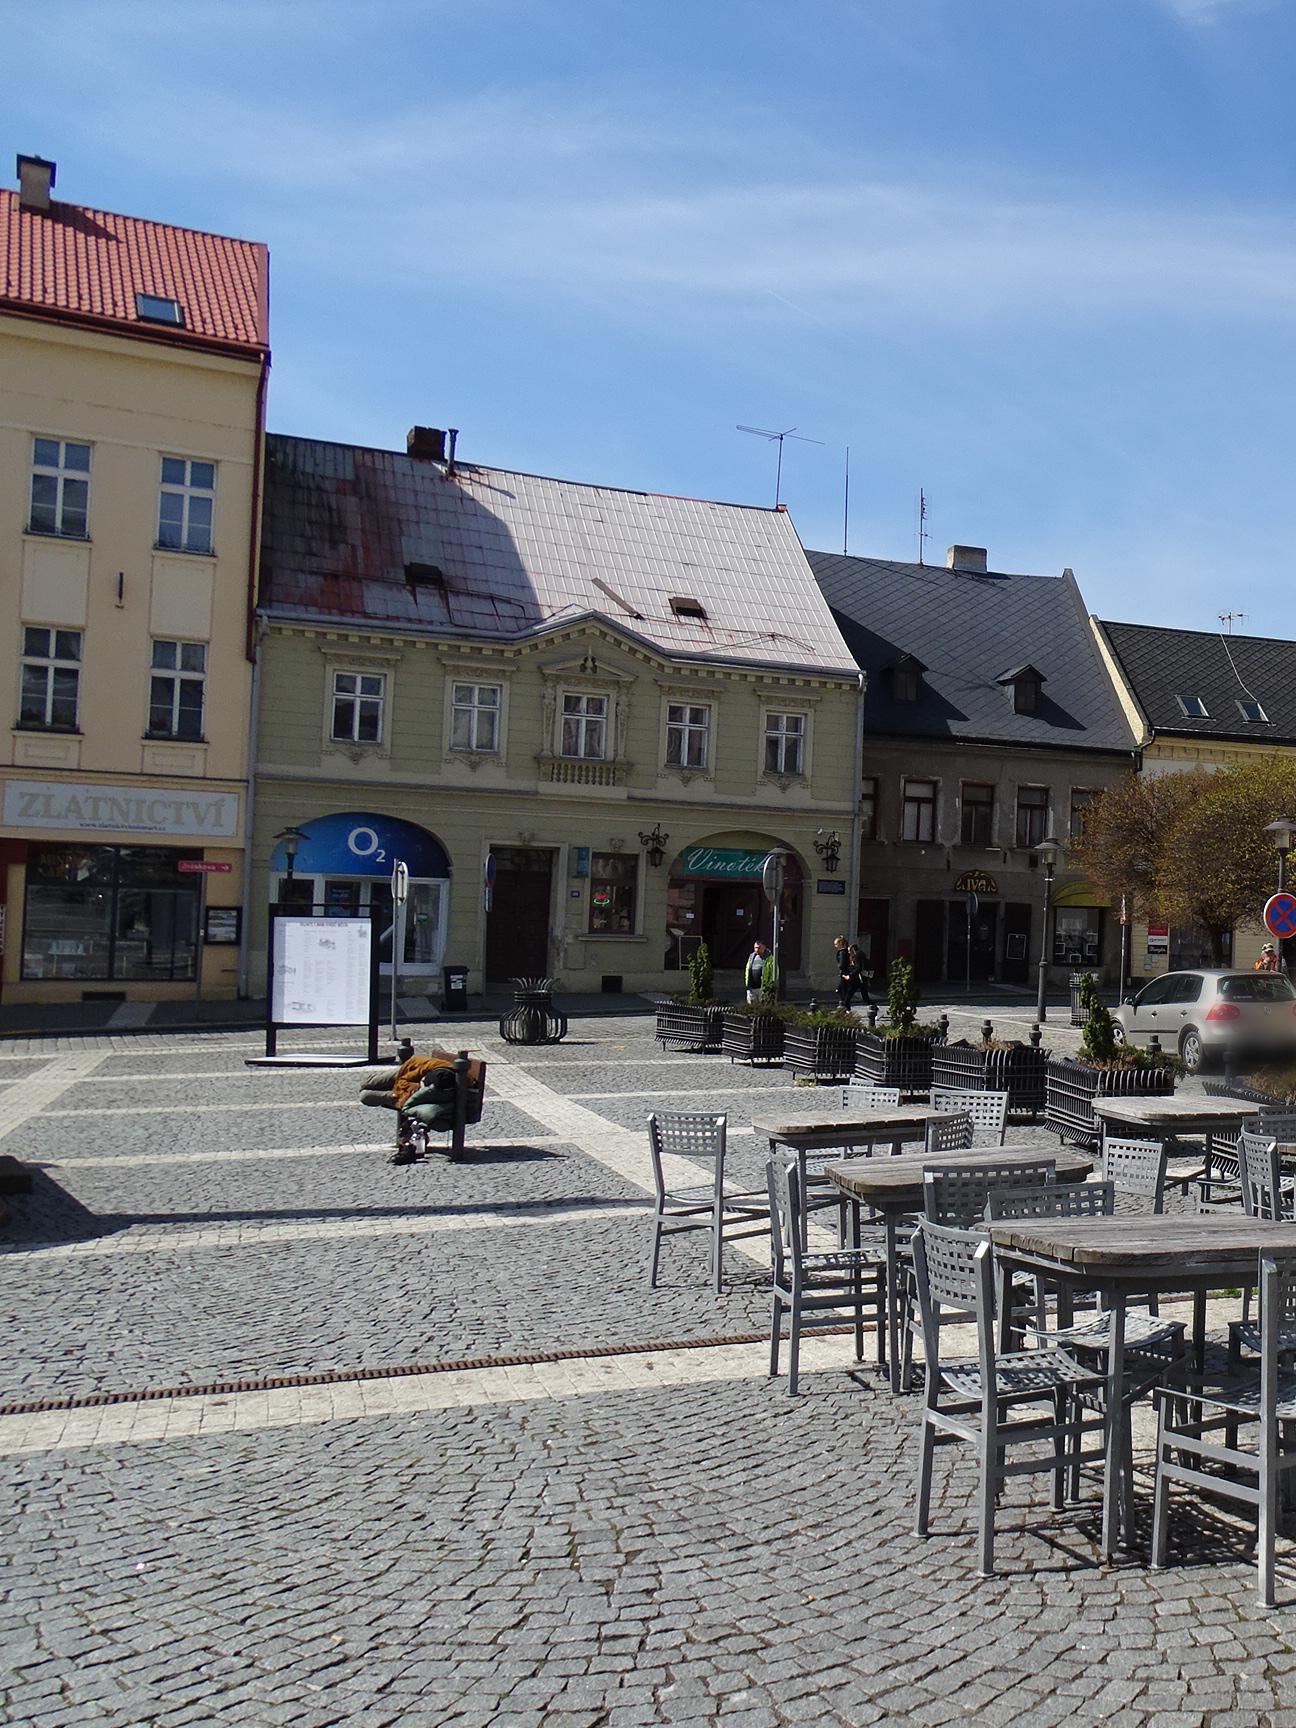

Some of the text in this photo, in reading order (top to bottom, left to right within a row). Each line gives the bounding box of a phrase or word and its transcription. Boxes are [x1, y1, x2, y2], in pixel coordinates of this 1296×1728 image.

[17, 791, 226, 828] ZLATNICTVÍ
[347, 826, 386, 863] O2
[687, 847, 767, 873] Vinoték
